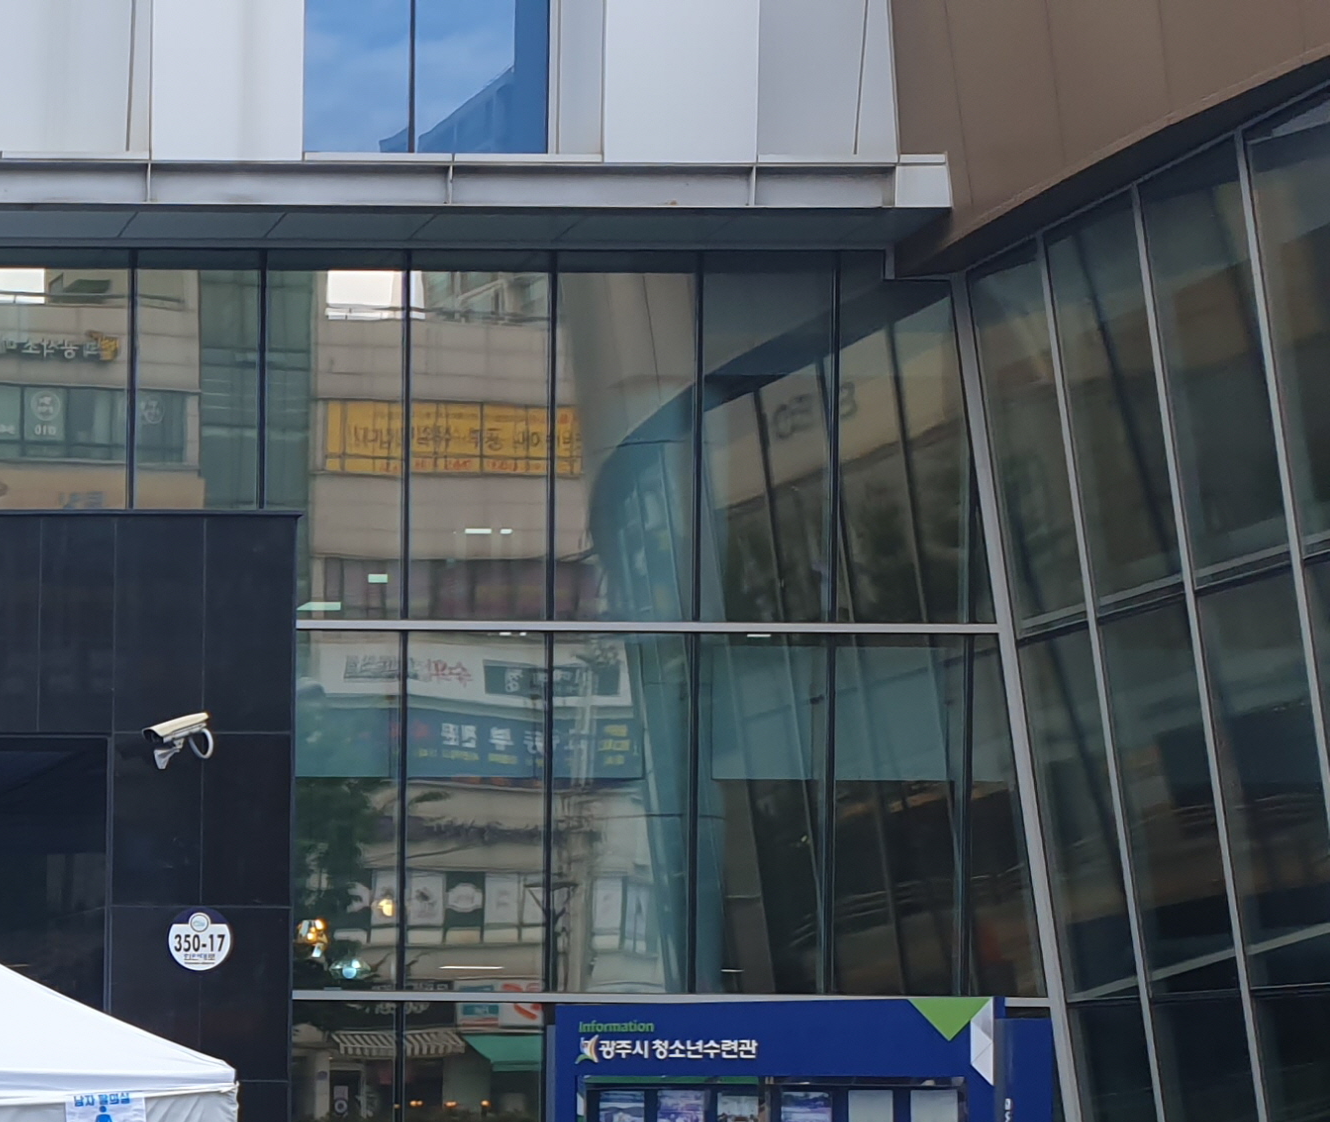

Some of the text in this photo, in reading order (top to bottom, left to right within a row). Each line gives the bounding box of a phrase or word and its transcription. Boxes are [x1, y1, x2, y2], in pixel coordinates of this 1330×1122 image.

[173, 933, 226, 952] 350-17
[579, 1021, 654, 1033] Information
[599, 1040, 758, 1060] 광주시 청소년수련관
